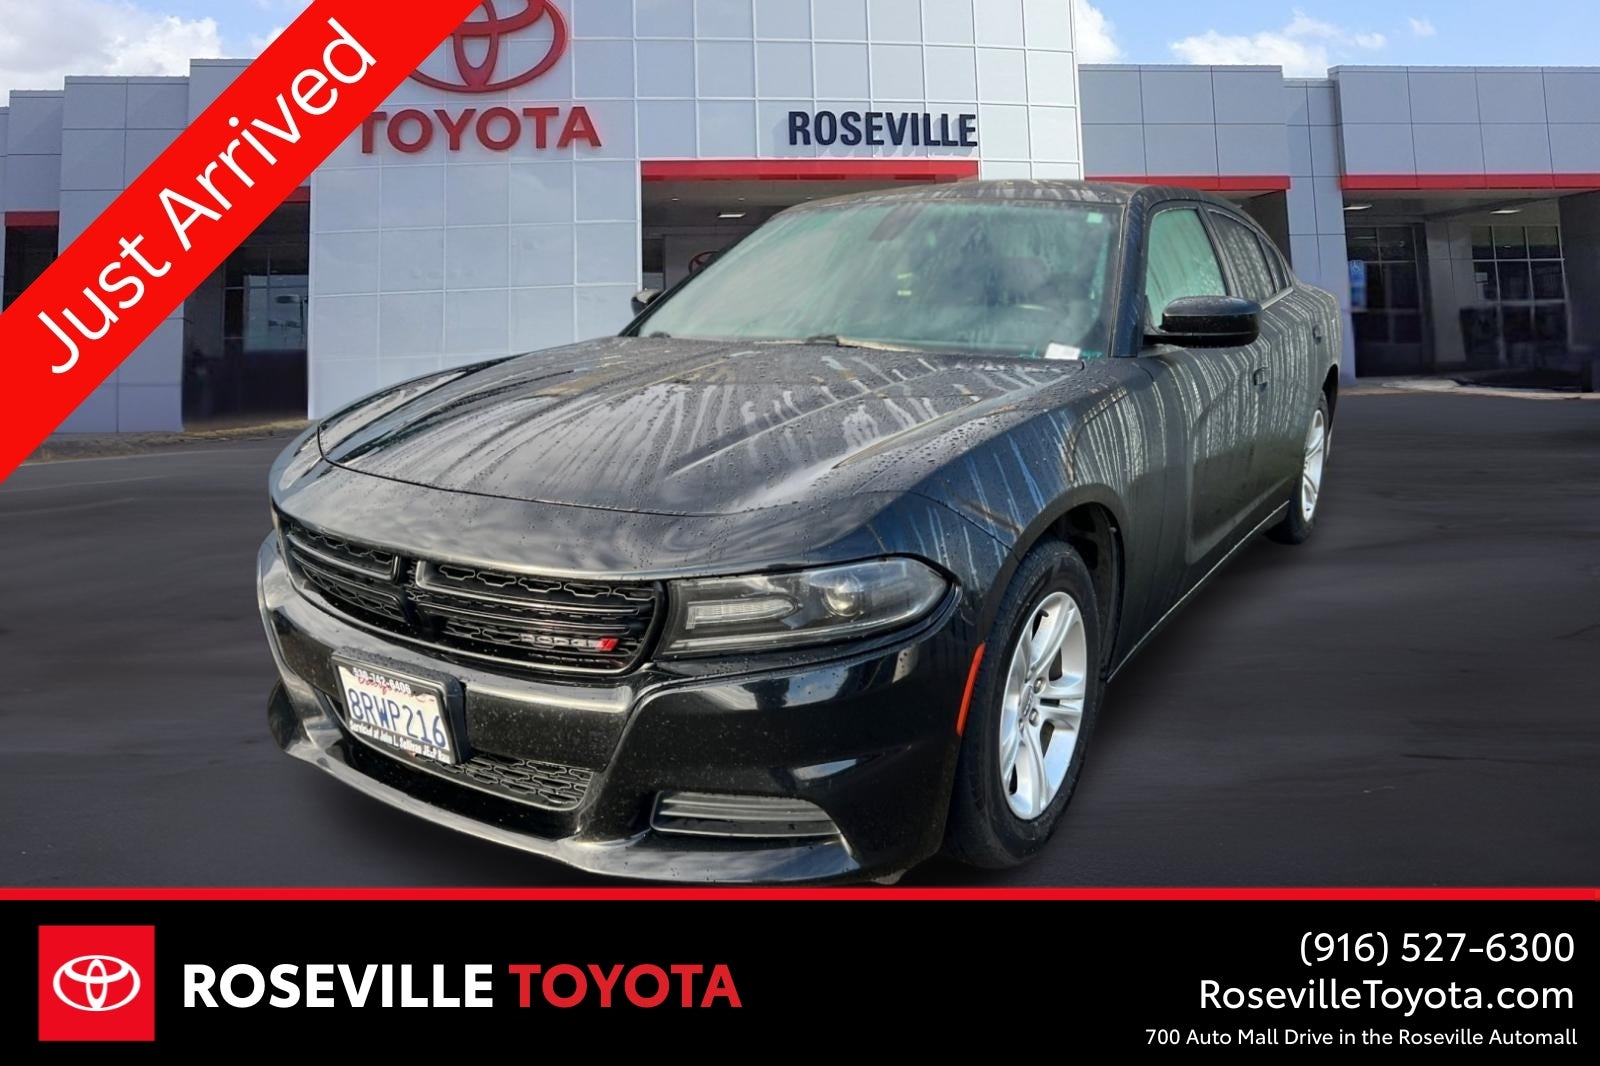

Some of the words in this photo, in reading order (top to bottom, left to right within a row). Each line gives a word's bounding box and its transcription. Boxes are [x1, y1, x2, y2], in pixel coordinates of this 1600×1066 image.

[361, 106, 602, 153] TOYOTA
[788, 111, 978, 147] ROSEVILLE
[348, 688, 446, 748] 8RWP216
